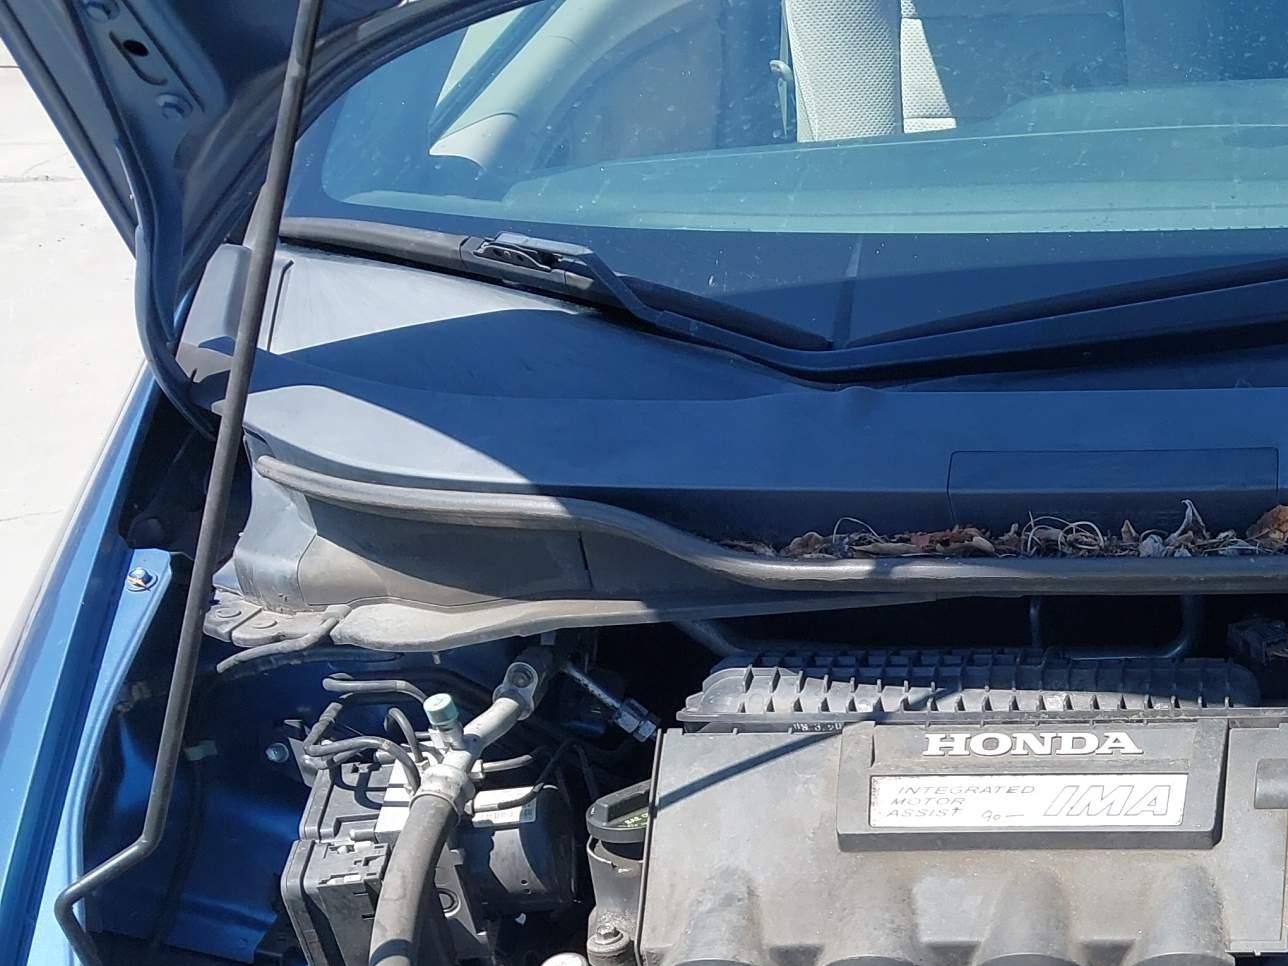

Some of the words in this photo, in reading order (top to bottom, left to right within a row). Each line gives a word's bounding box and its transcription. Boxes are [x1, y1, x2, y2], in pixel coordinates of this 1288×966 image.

[922, 731, 1143, 757] HONDA
[898, 785, 1036, 794] INTEGRATED
[890, 797, 966, 806] MOTOR
[1043, 784, 1174, 817] IMA
